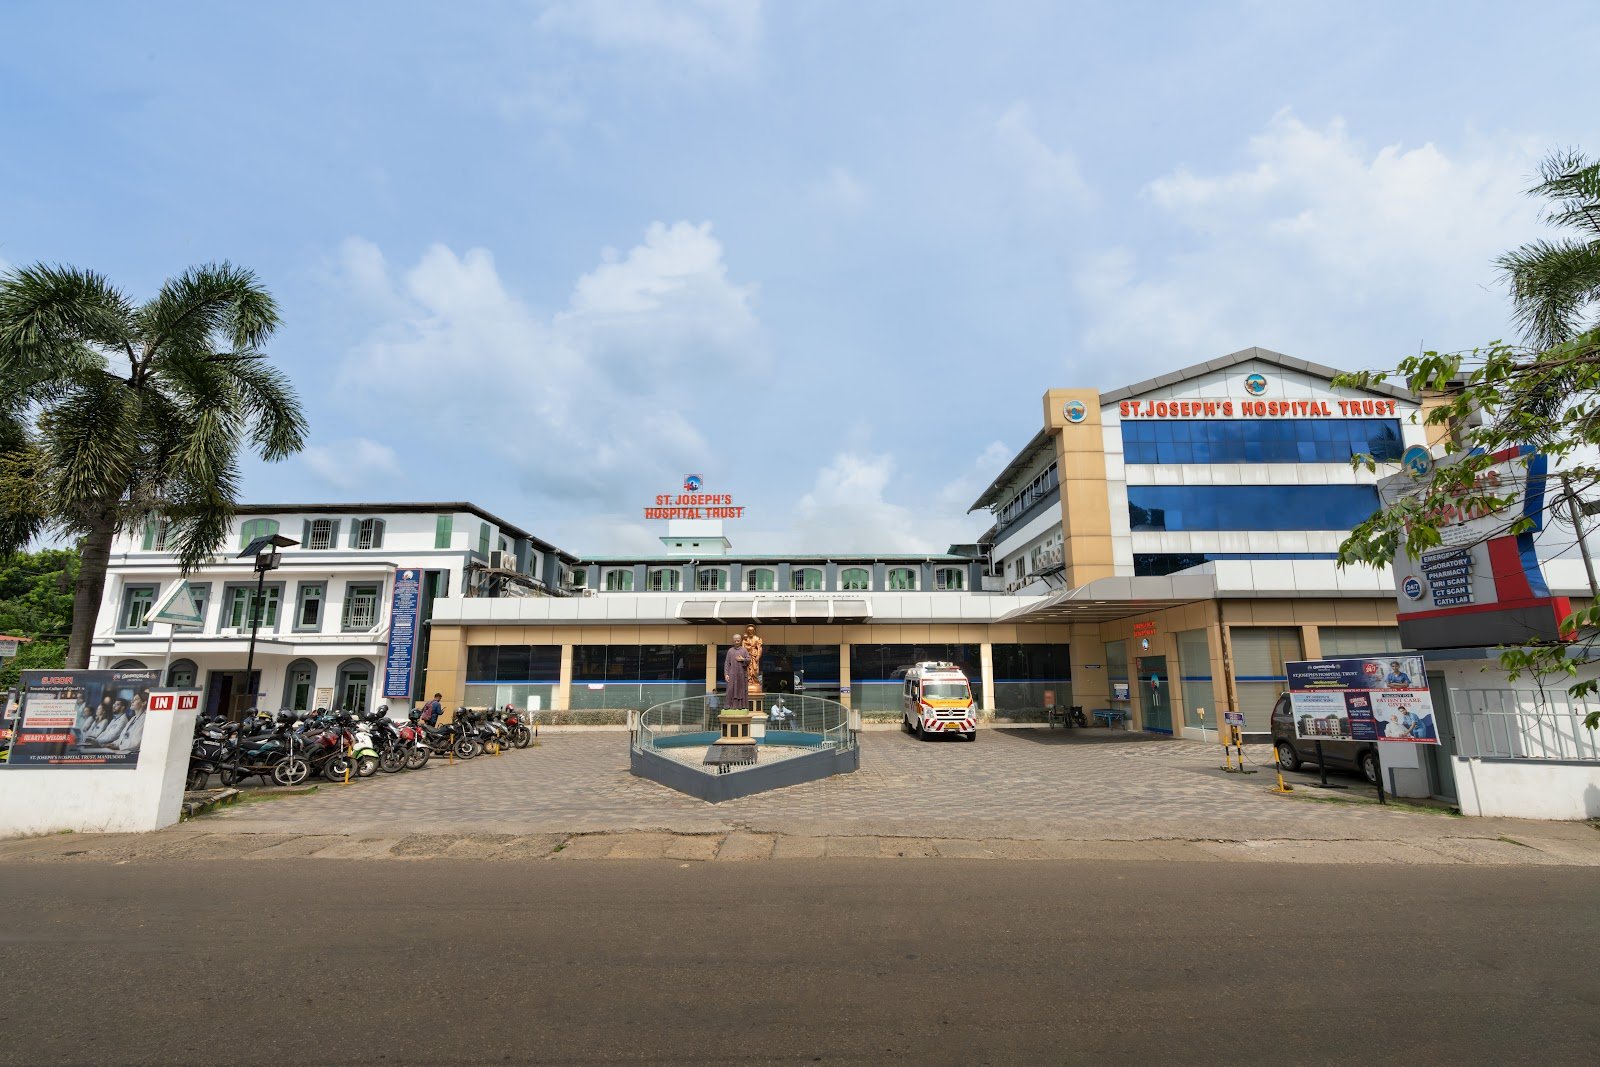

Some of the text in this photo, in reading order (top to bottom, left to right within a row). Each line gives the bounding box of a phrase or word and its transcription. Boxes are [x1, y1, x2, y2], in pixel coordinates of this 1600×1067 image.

[1120, 400, 1396, 417] ST.JOSEPH'S HOSPITAL TRUST
[656, 494, 732, 506] ST. JOSEPH'S
[645, 507, 743, 519] HOSPITAL TRUST
[1428, 568, 1466, 579] PHARMACY
[1406, 583, 1418, 591] 24/7
[1432, 577, 1466, 588] MRI SCAN
[1446, 587, 1466, 595] SCAN
[1455, 596, 1468, 604] LAB
[41, 676, 73, 684] SJCON
[155, 697, 168, 708] IN
[182, 697, 194, 708] IN
